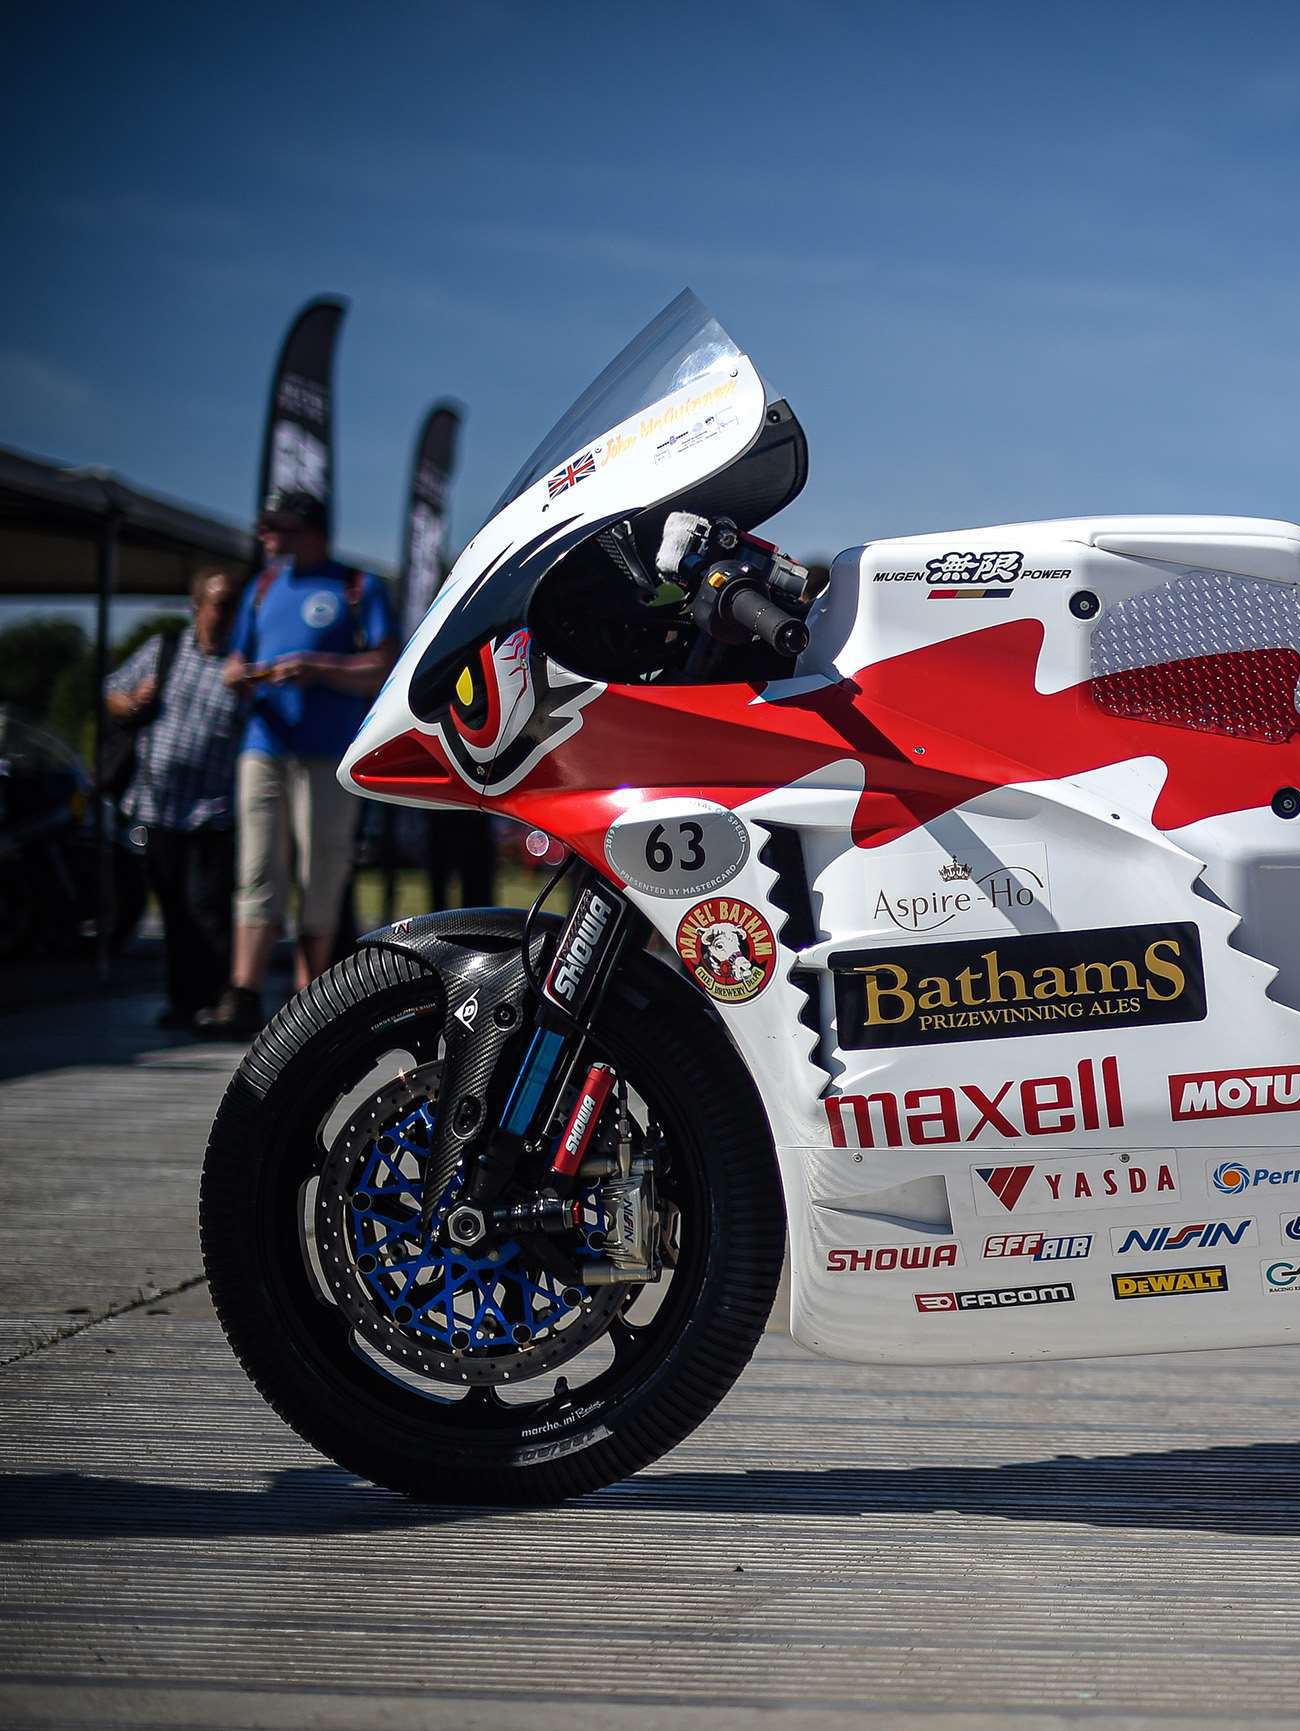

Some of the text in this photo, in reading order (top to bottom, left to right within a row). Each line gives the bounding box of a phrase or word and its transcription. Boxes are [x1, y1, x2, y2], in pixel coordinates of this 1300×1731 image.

[873, 551, 1072, 584] MUGEN 無限 POWER
[727, 815, 747, 843] SPEED
[645, 821, 706, 873] 63
[619, 863, 738, 897] PRESENTED BY MASTERCARD
[719, 901, 773, 957] BATHAM
[554, 894, 613, 1001] SHOWA
[714, 986, 746, 997] BREWERY
[919, 997, 1141, 1032] PRIZEWINNING ALES
[825, 1055, 1125, 1149] maxell
[565, 1094, 596, 1156] SHOWA
[1044, 1164, 1176, 1200] YASDA
[826, 1244, 958, 1272] SHOWA
[960, 1285, 1072, 1308] FACOM
[1269, 1286, 1294, 1294] RACING
